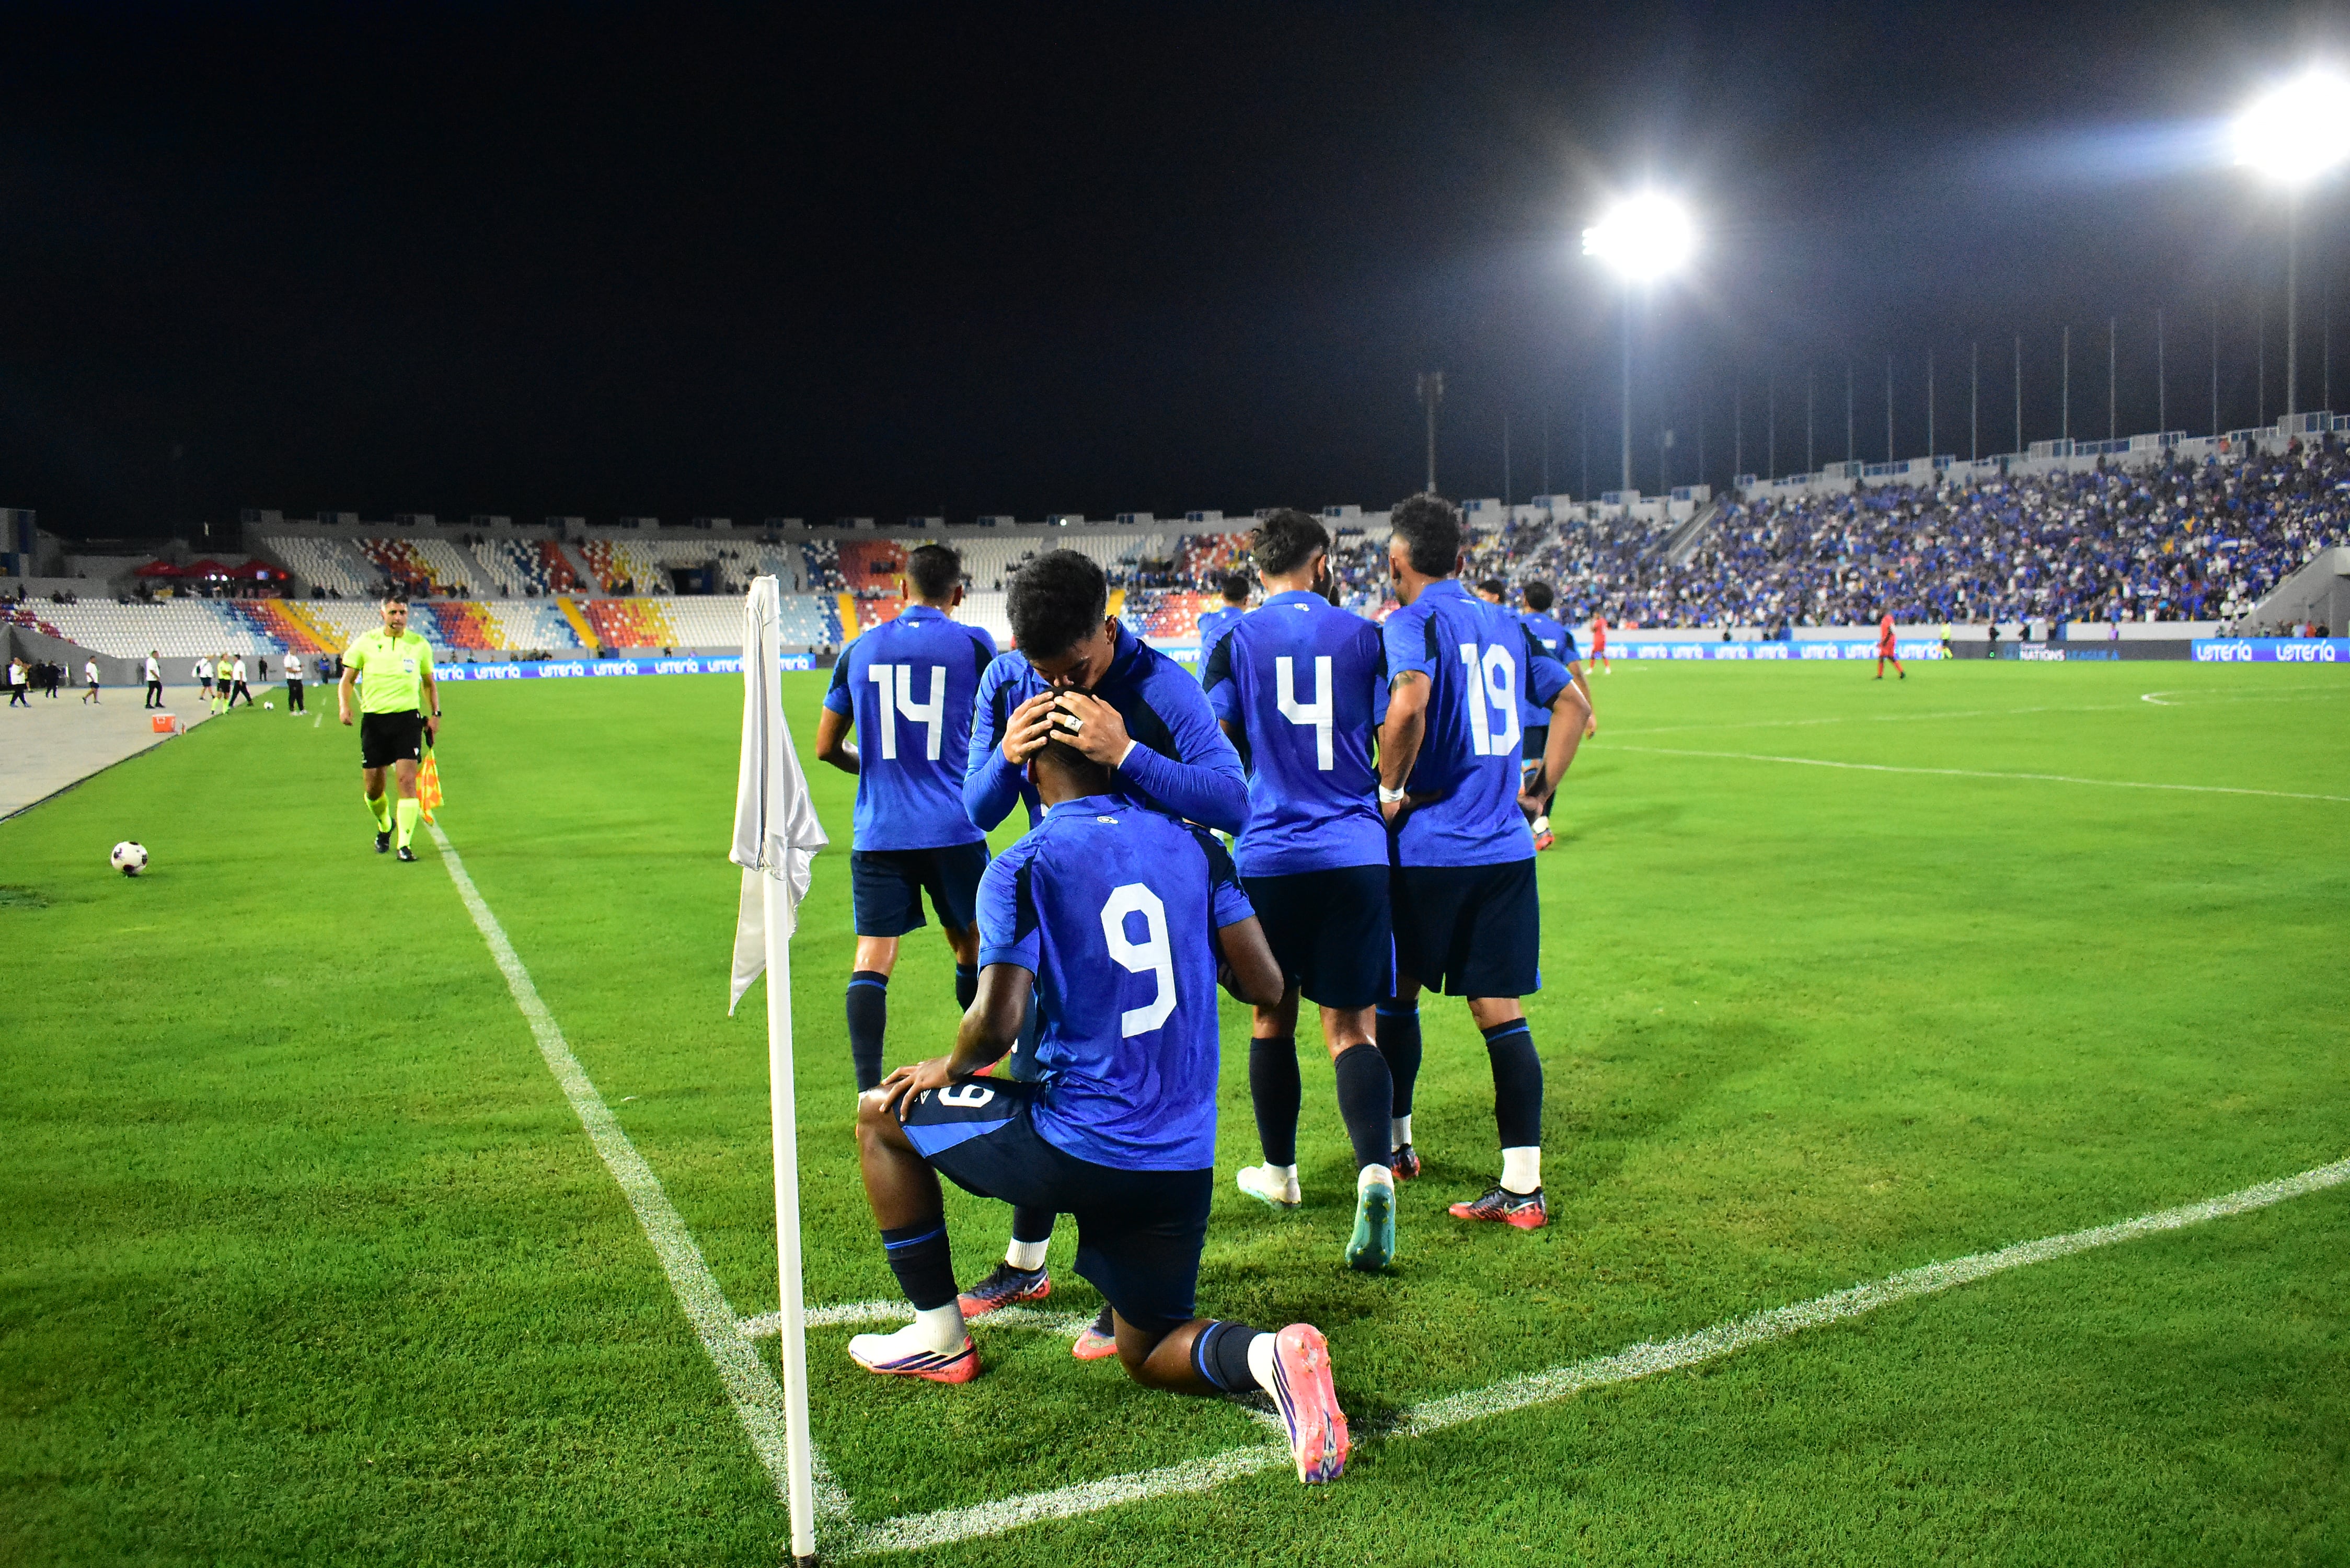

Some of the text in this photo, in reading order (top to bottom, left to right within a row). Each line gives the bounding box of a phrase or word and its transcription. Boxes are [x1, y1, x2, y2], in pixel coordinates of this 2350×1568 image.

[433, 664, 465, 680] TERÍA
[707, 656, 744, 672] LOTERÍ
[780, 655, 809, 671] TERÍA
[1460, 643, 1521, 756] 19
[2020, 649, 2065, 661] NATIONS
[868, 664, 946, 761] 14
[1276, 656, 1333, 771] 4
[1100, 882, 1178, 1039] 9
[938, 1083, 995, 1108] 9
